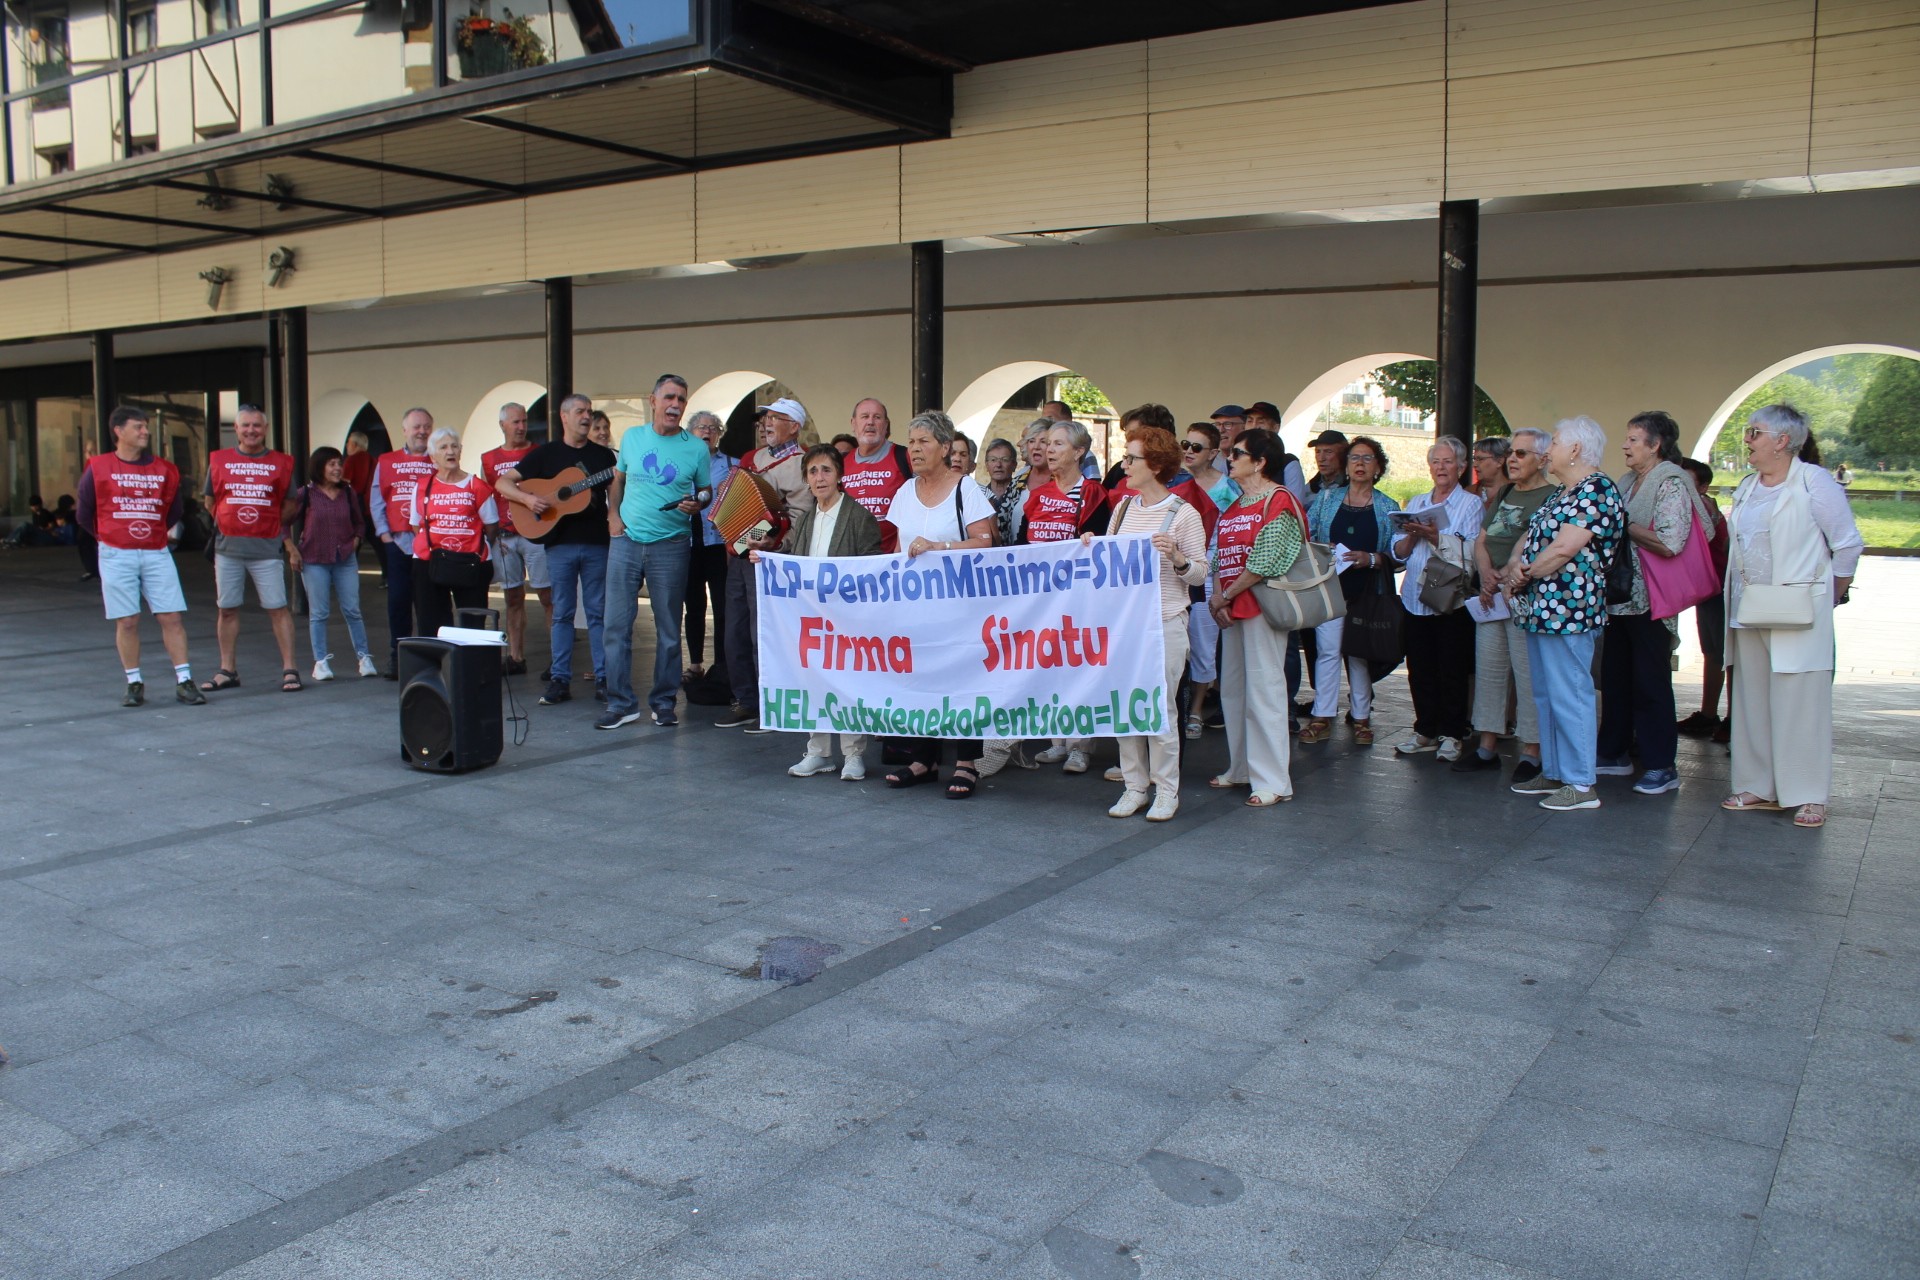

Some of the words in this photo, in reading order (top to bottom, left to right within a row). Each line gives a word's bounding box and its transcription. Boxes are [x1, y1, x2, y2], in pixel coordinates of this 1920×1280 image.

[225, 462, 276, 471] GUTXIENEKO
[225, 483, 273, 492] GUTXIENEKO
[1028, 521, 1077, 533] GUTXIENEK
[1033, 530, 1075, 540] SOLDATA
[799, 616, 913, 674] Firma
[981, 614, 1109, 673] Sinatu
